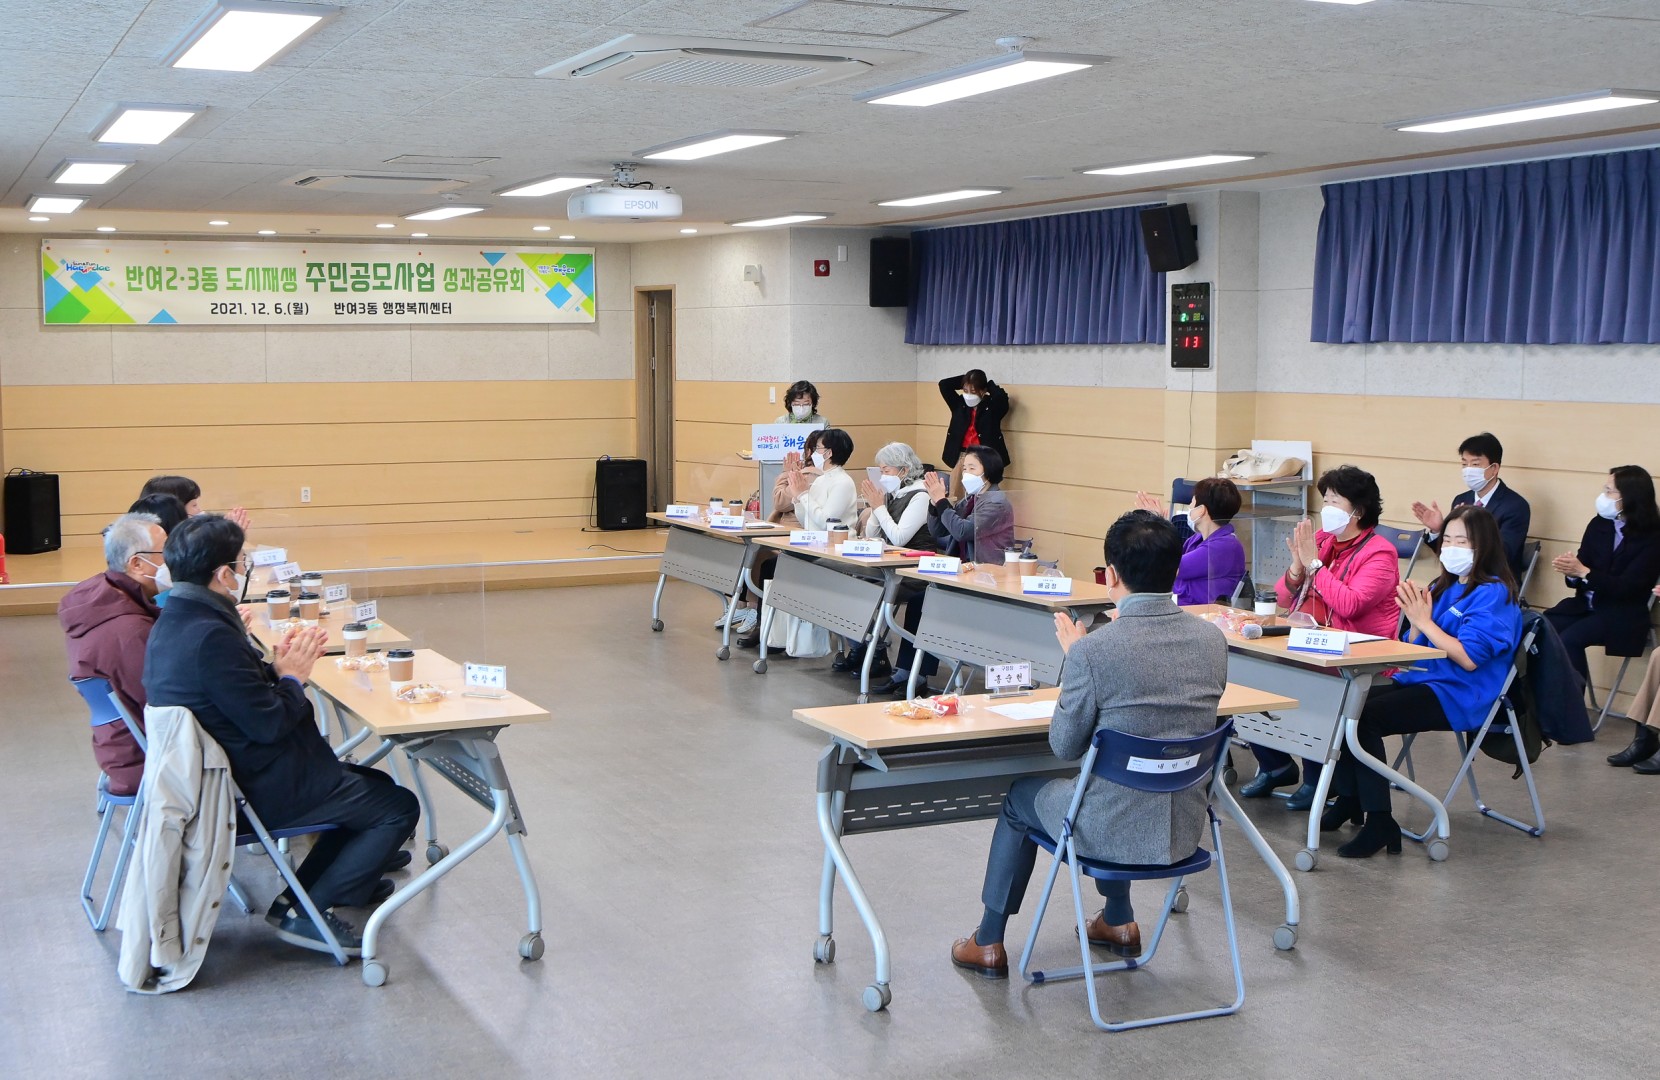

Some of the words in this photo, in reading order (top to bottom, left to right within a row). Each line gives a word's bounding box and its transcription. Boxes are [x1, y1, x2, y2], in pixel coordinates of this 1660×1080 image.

[624, 200, 659, 210] EPSON
[225, 266, 298, 293] 도시재생
[304, 262, 435, 293] 주민공모사업
[442, 267, 526, 293] 성과공유회
[333, 301, 379, 316] 반여3동
[382, 301, 453, 316] 행정복지센터
[782, 435, 806, 450] 해운
[1305, 636, 1328, 646] 김은진
